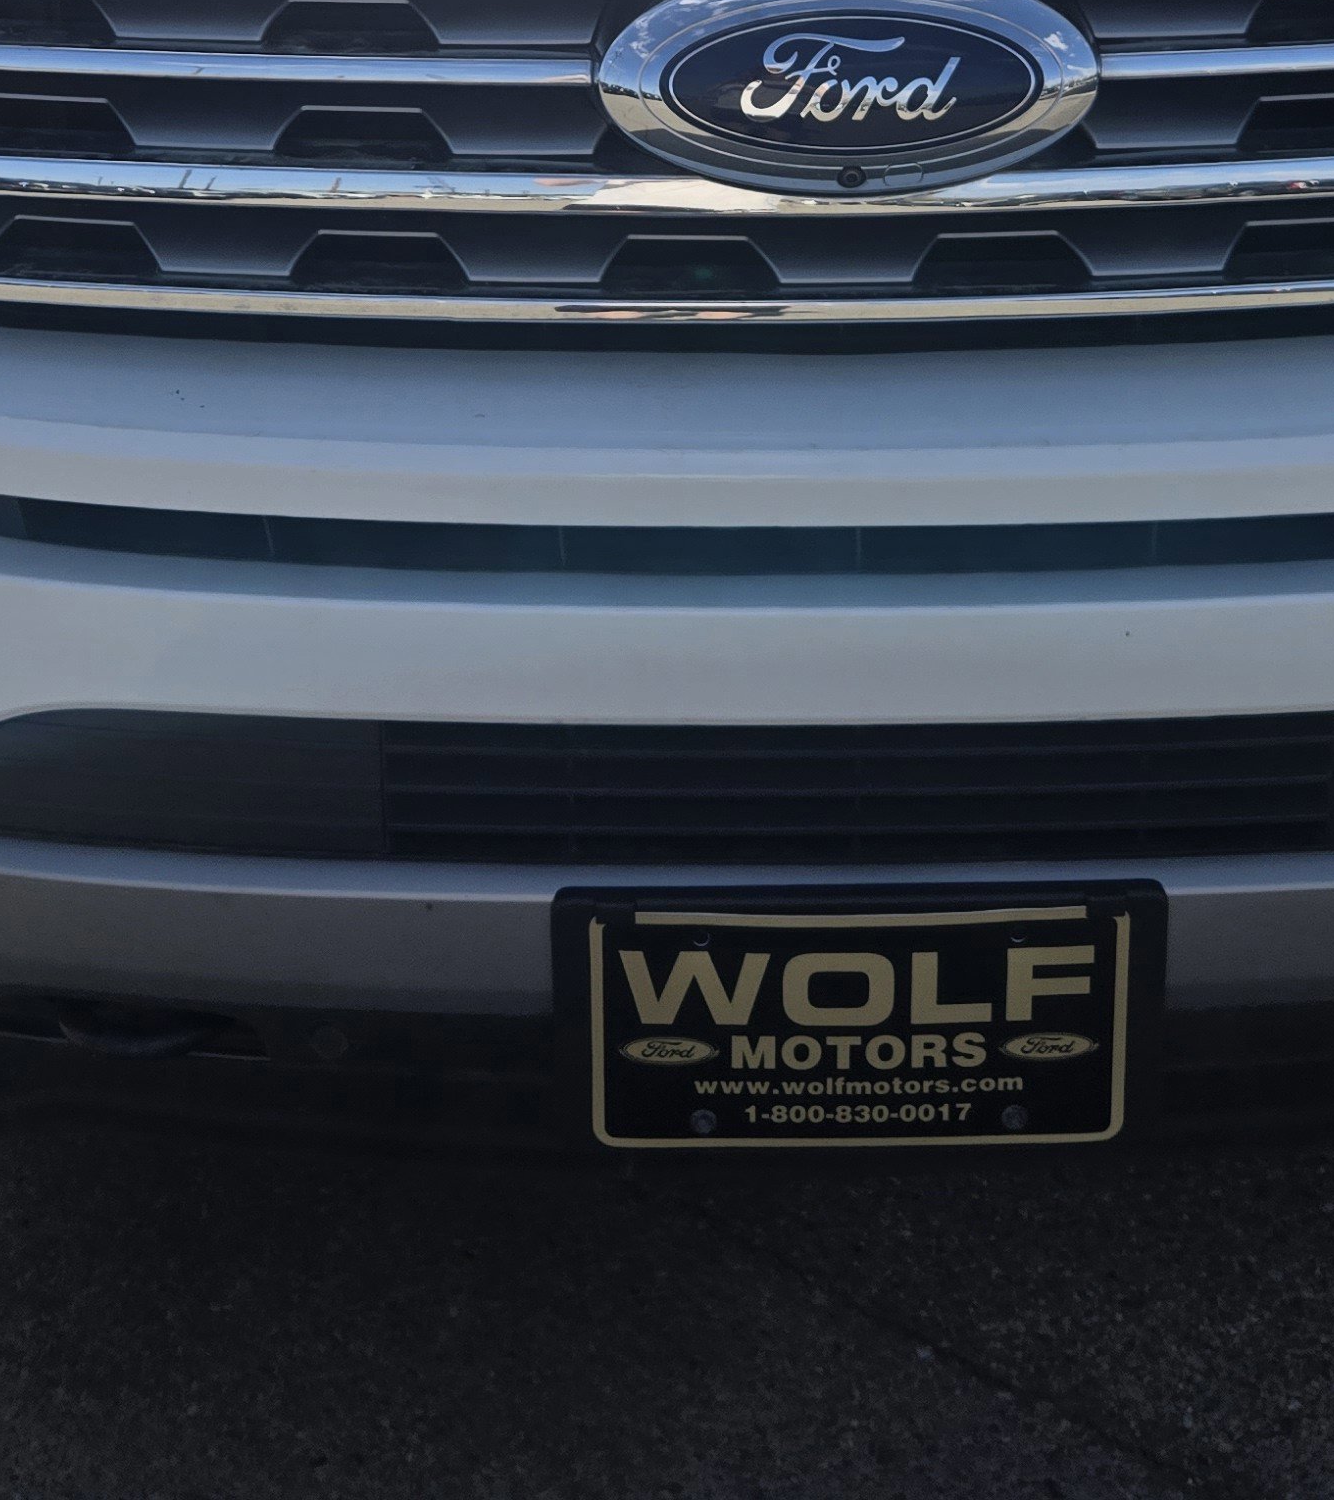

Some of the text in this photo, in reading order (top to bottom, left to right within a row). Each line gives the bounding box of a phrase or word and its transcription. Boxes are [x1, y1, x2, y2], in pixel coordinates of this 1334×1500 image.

[740, 32, 961, 122] Ford
[618, 945, 1096, 1026] WOLF
[731, 1032, 987, 1070] MOTORS
[694, 1076, 1024, 1096] www.wolfmotors.com
[744, 1103, 972, 1124] 1-800-830-0017
